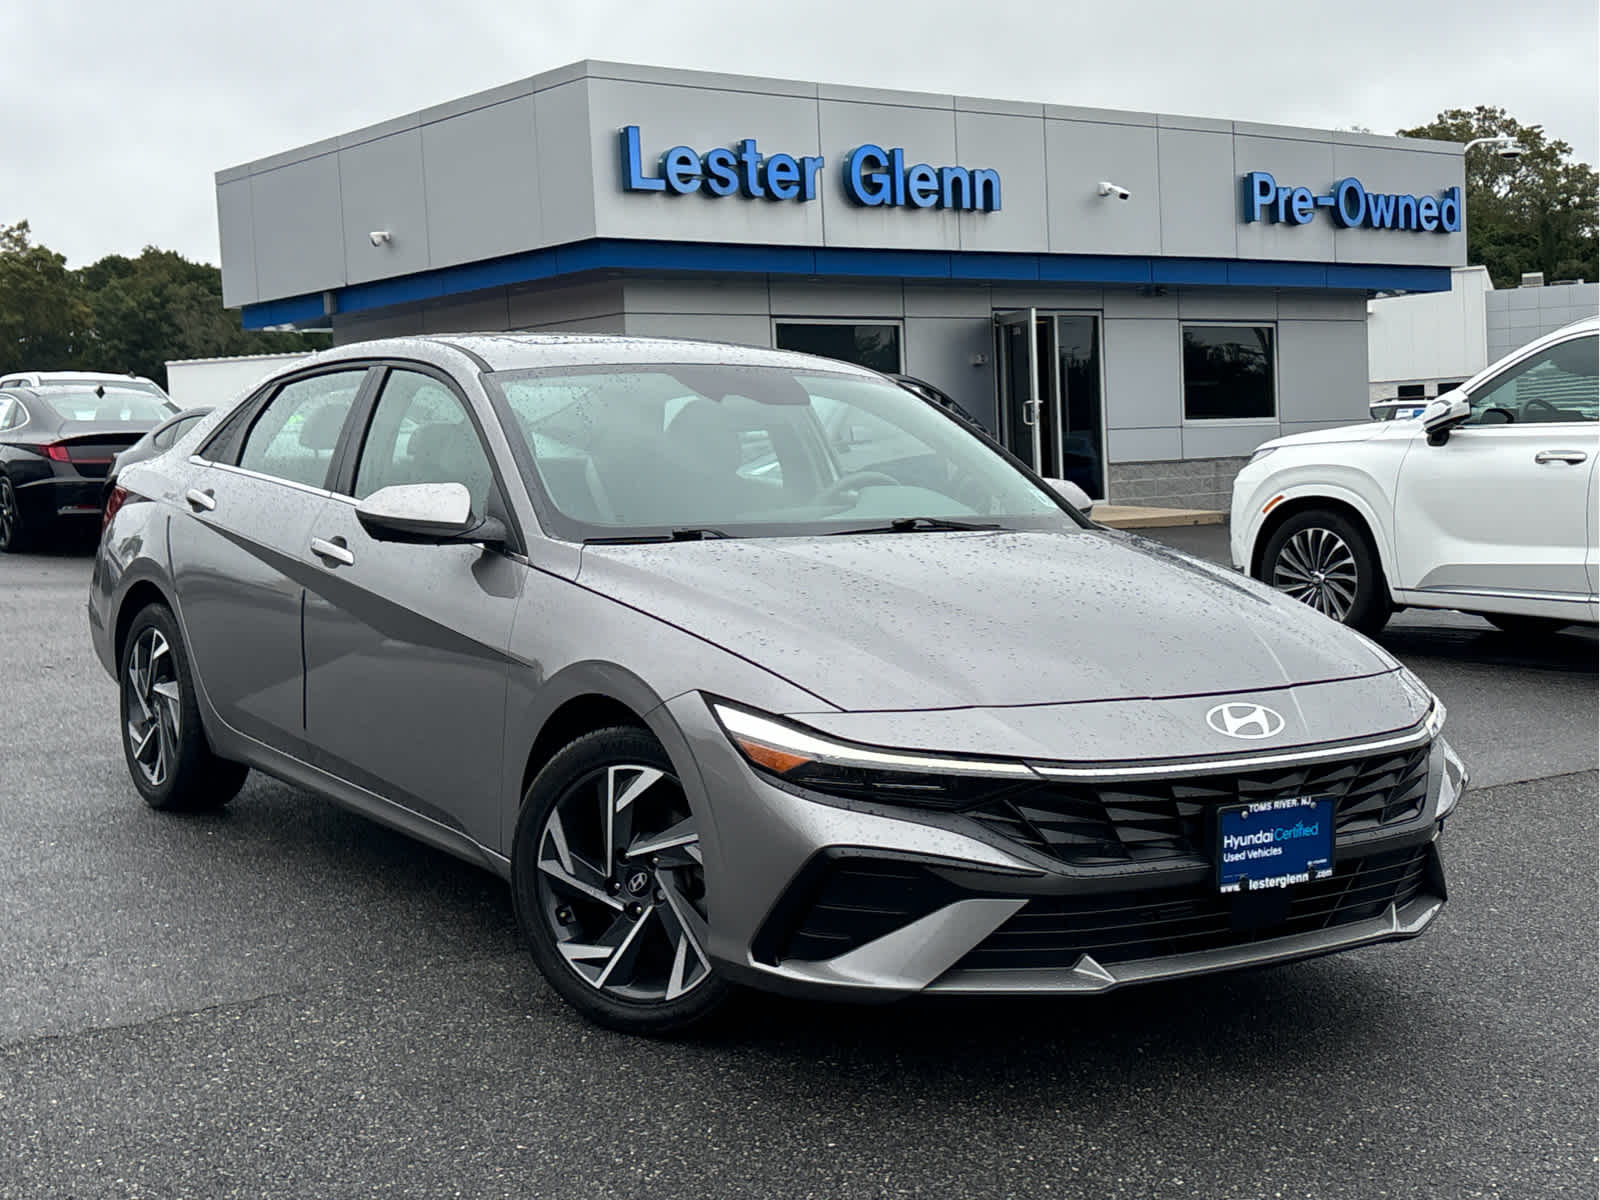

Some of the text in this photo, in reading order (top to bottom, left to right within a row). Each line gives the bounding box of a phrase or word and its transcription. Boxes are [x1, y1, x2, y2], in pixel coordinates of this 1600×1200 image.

[620, 125, 1002, 212] Lester Glenn
[1244, 171, 1462, 233] Pre-Owned
[1248, 802, 1272, 813] TOMS
[1223, 820, 1319, 849] Hyundai Certified
[1223, 846, 1283, 863] Used Vehicles
[1248, 873, 1309, 890] lesterglenn
